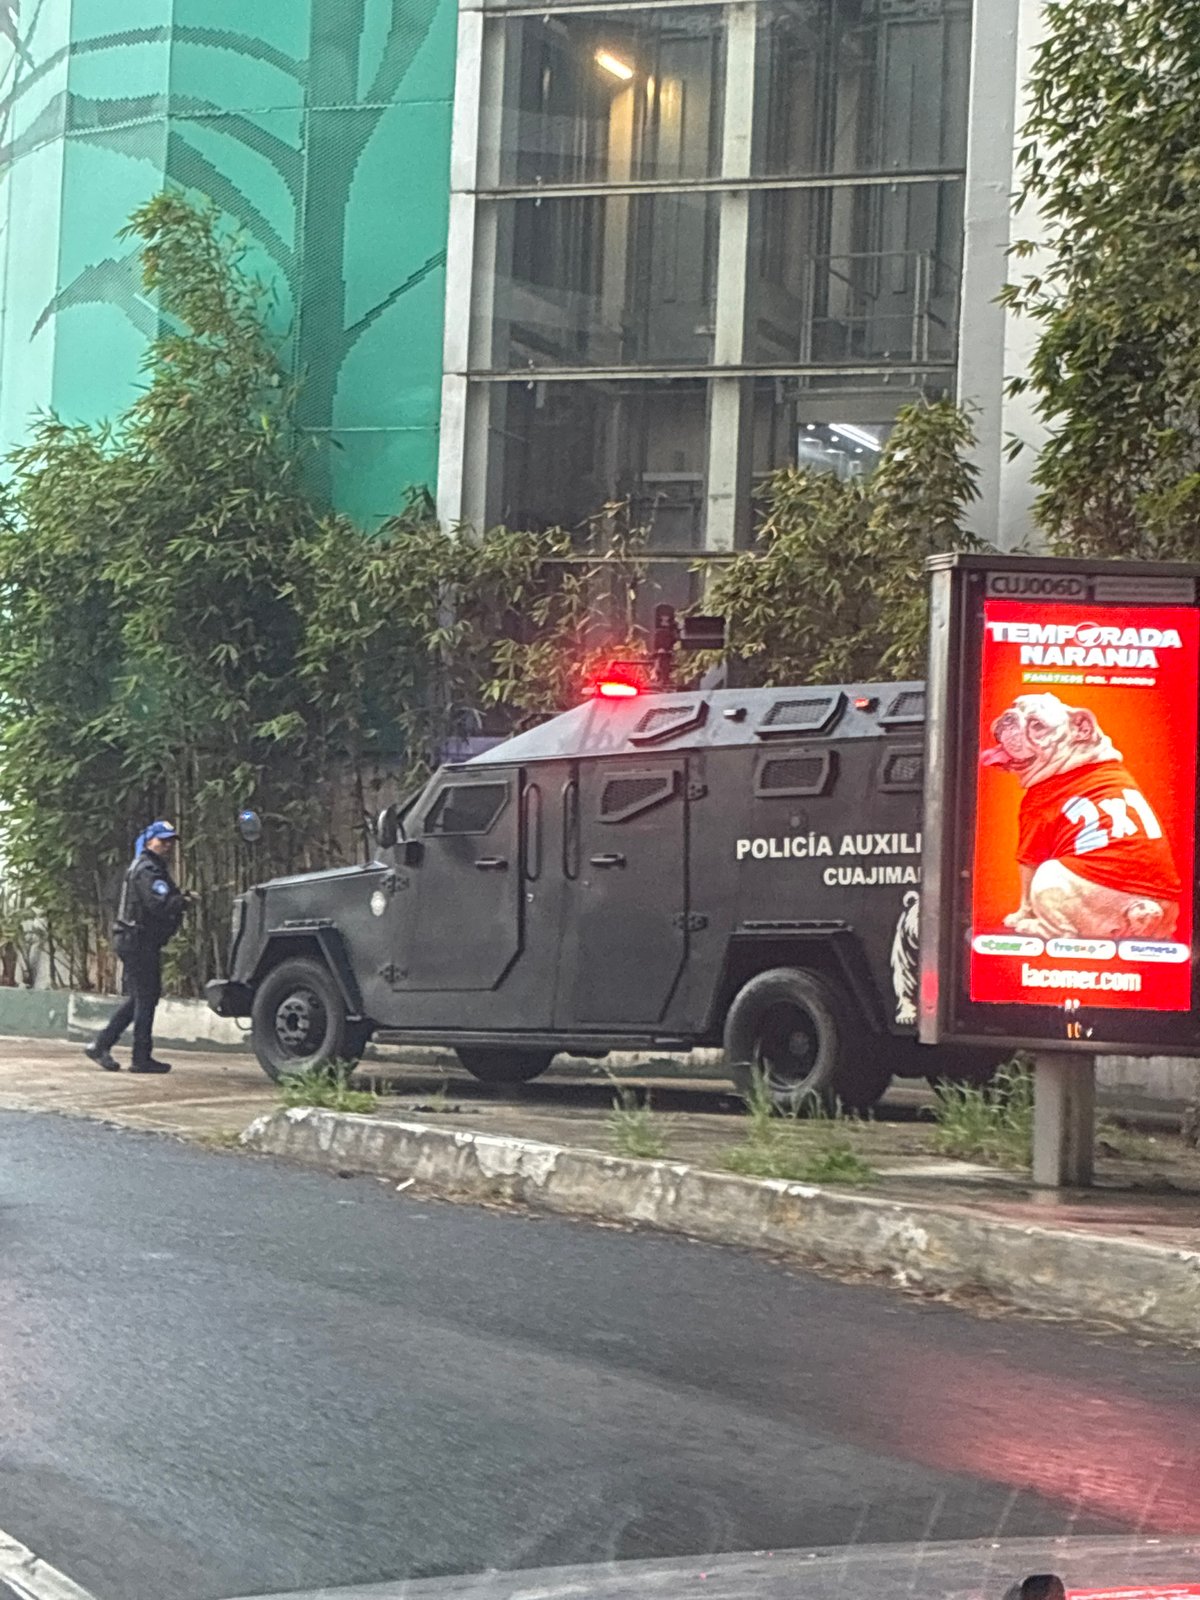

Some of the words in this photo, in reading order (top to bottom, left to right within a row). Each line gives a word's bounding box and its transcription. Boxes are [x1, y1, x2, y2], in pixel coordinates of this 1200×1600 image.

[989, 575, 1082, 597] CUJ006D
[985, 621, 1183, 649] TEMPORADA
[1020, 645, 1159, 669] NARANJA
[736, 831, 833, 860] POLICÍA
[839, 832, 922, 856] AUXILI
[823, 865, 921, 886] CUAJIMA
[1021, 962, 1142, 992] lacomer.com
